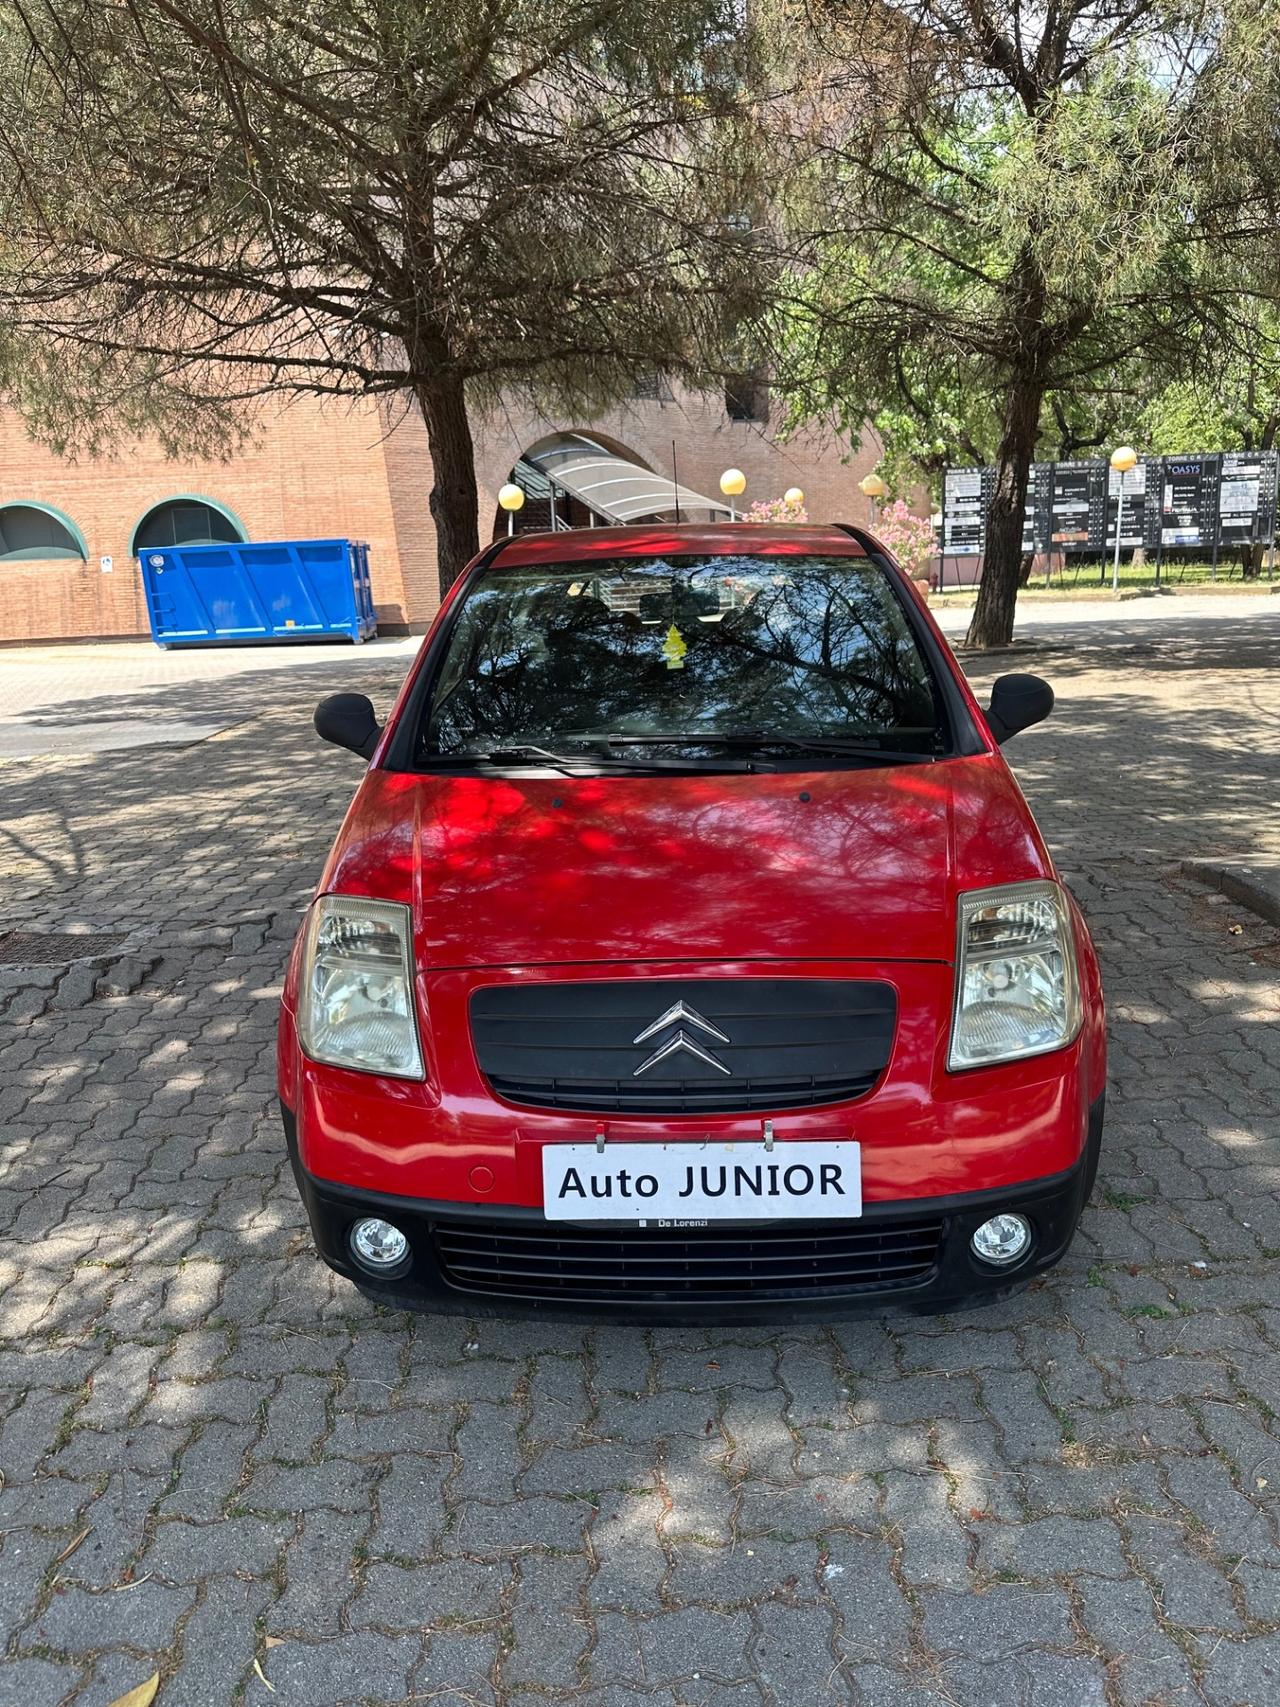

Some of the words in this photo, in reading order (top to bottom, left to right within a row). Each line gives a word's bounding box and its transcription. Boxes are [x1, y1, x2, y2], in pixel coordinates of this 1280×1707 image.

[1172, 464, 1200, 474] OASYS
[558, 1167, 659, 1198] Auto
[678, 1164, 845, 1197] JUNIOR
[658, 1219, 671, 1228] De
[674, 1218, 708, 1227] Lorenzi
